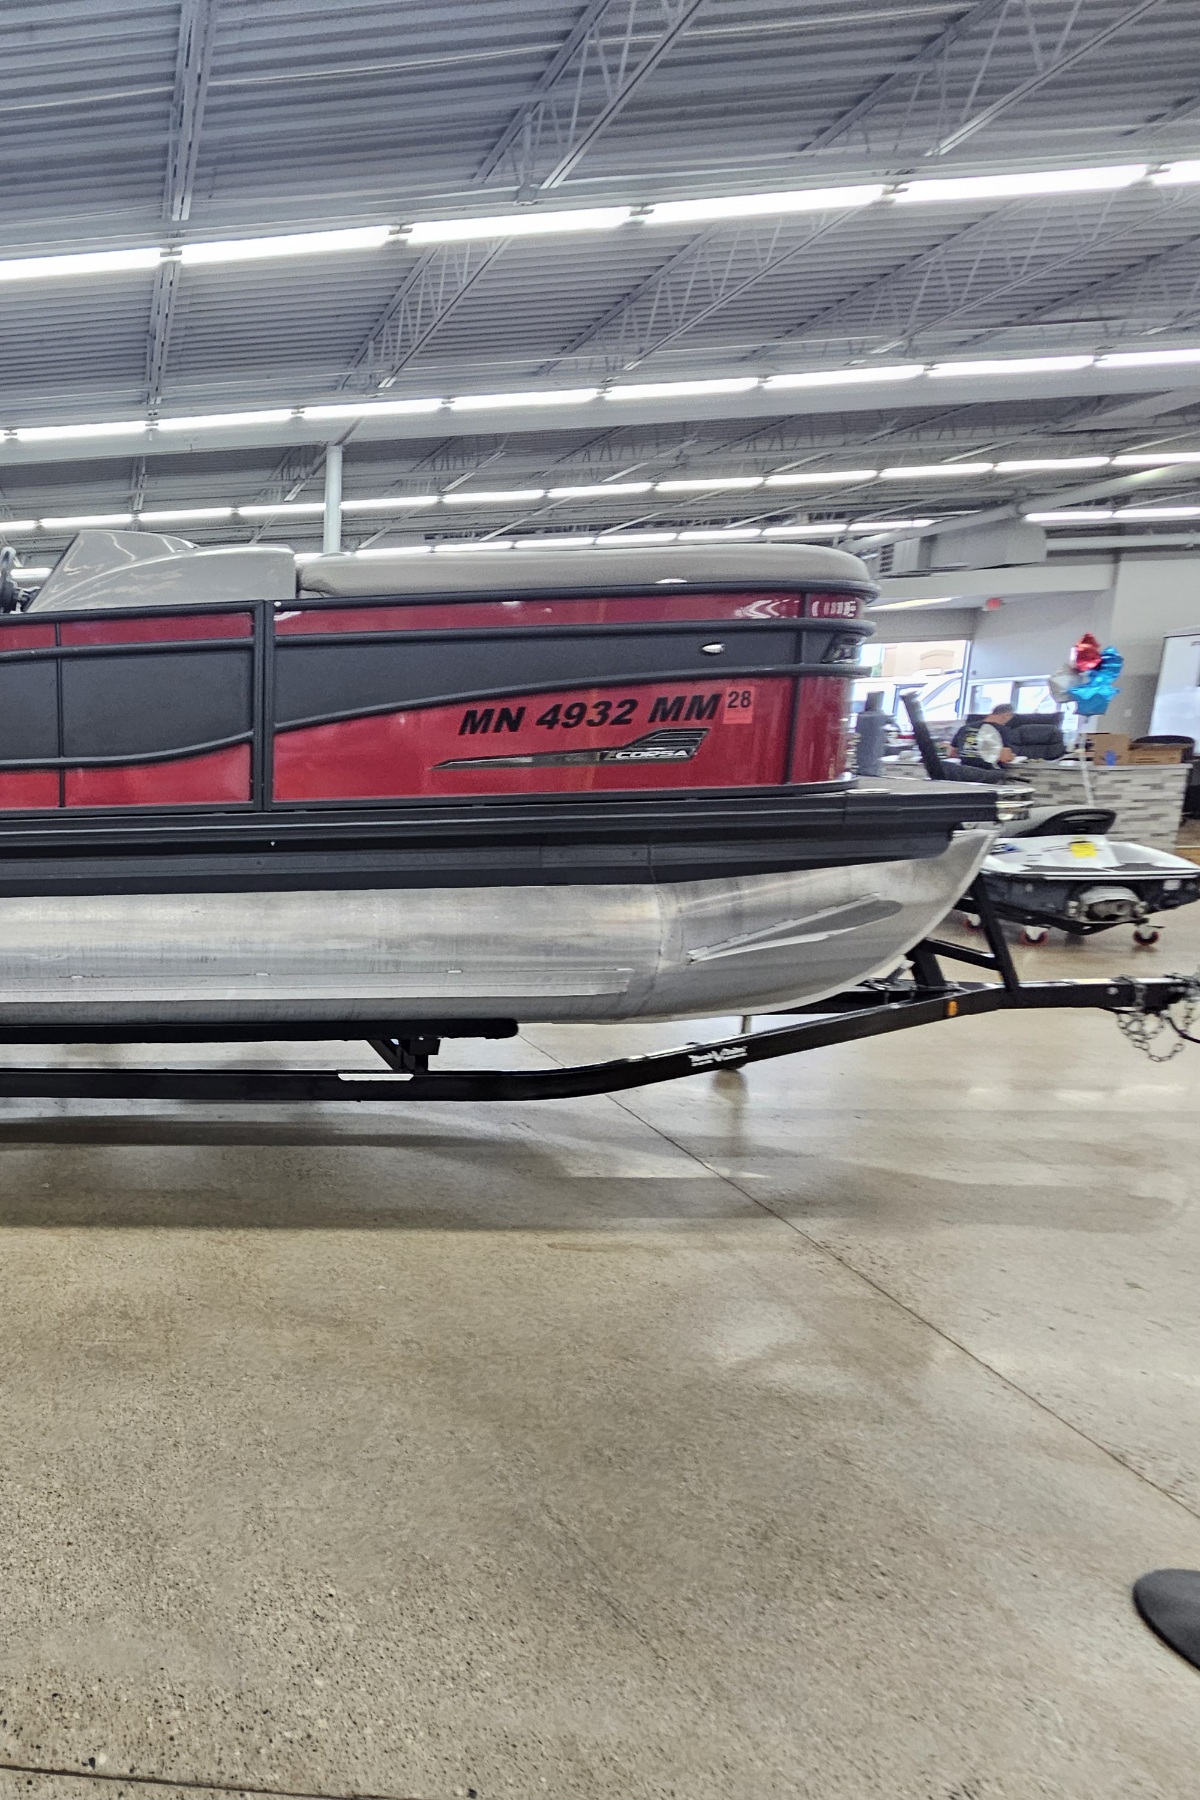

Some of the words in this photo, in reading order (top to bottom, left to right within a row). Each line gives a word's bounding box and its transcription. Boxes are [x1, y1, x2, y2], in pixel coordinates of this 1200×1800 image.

[727, 690, 752, 709] 28
[458, 706, 526, 735] MN
[535, 699, 639, 730] 4932
[647, 693, 722, 723] MM
[615, 750, 688, 760] CORSA
